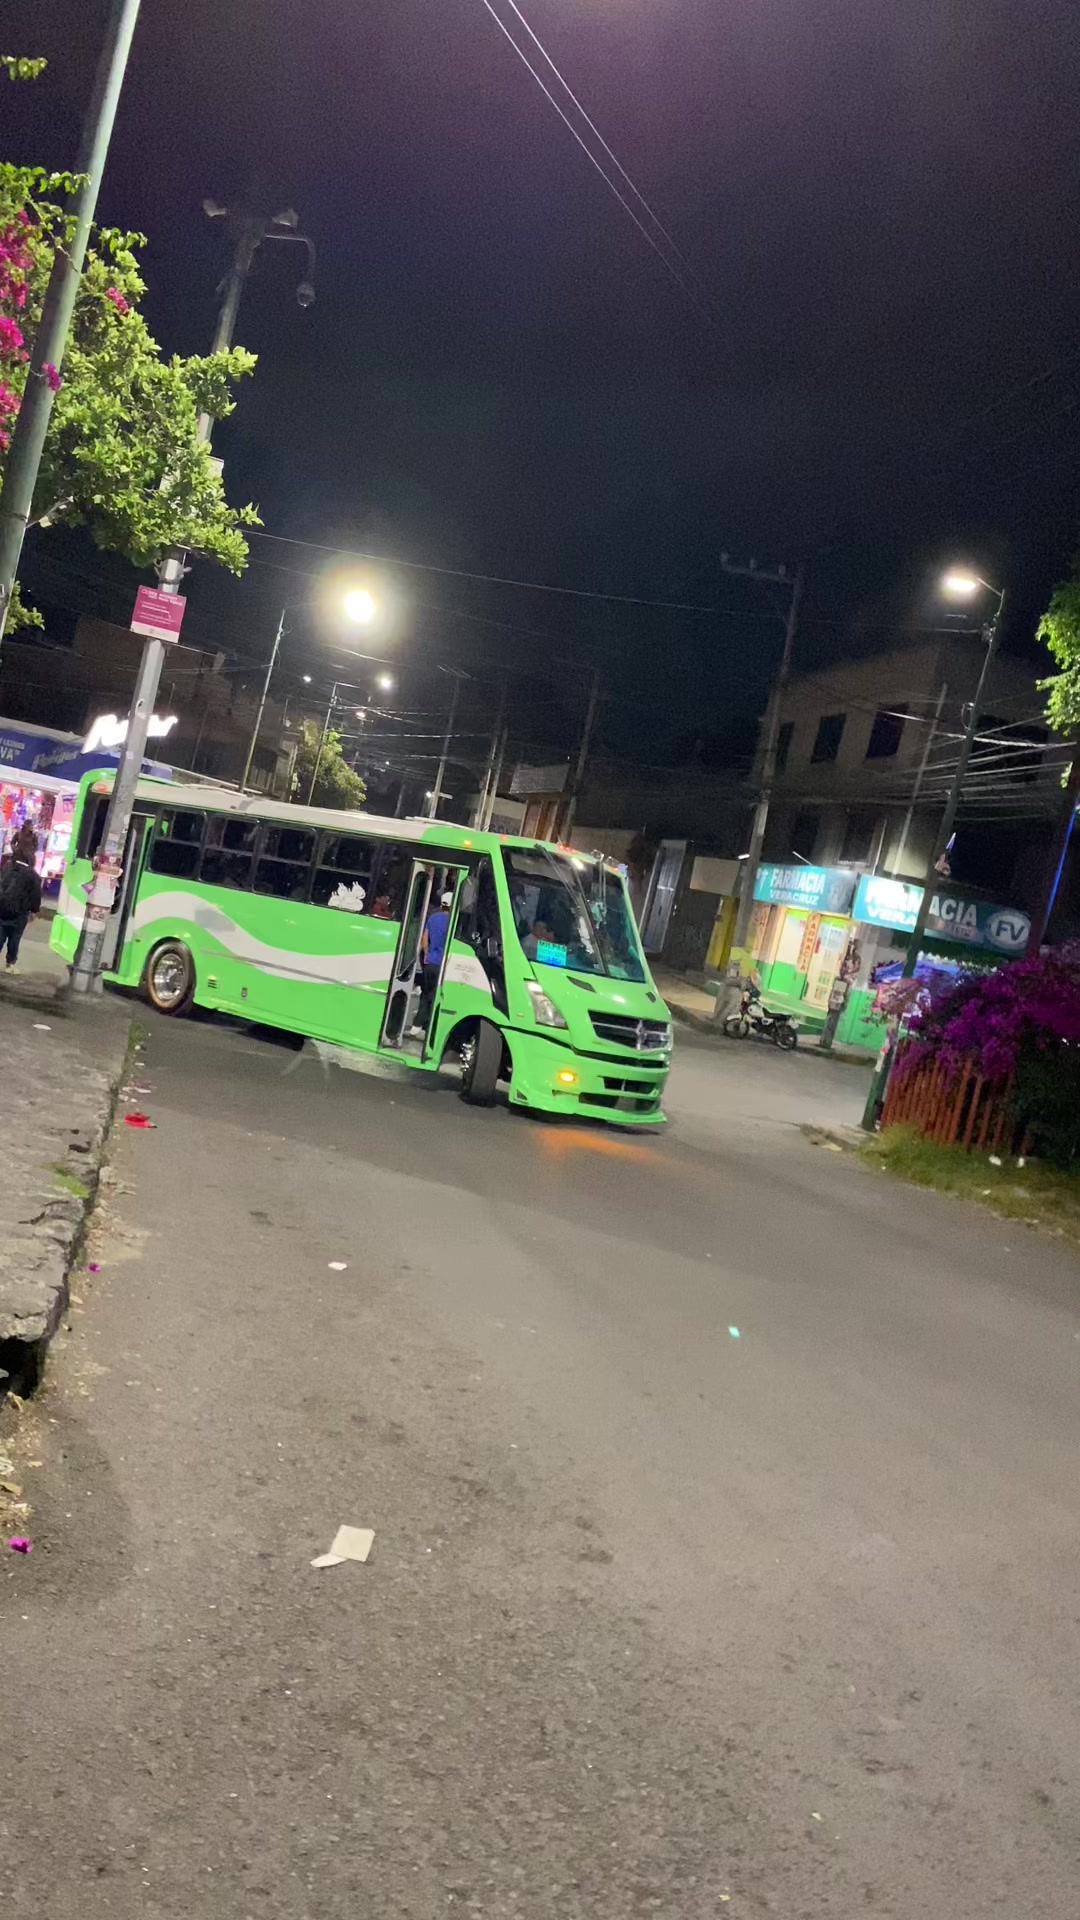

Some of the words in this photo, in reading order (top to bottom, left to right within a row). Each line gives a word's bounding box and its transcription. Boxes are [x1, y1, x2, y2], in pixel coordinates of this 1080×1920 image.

[769, 868, 826, 895] FARMACIA
[769, 890, 820, 906] VERACRUZ
[995, 919, 1026, 942] FV
